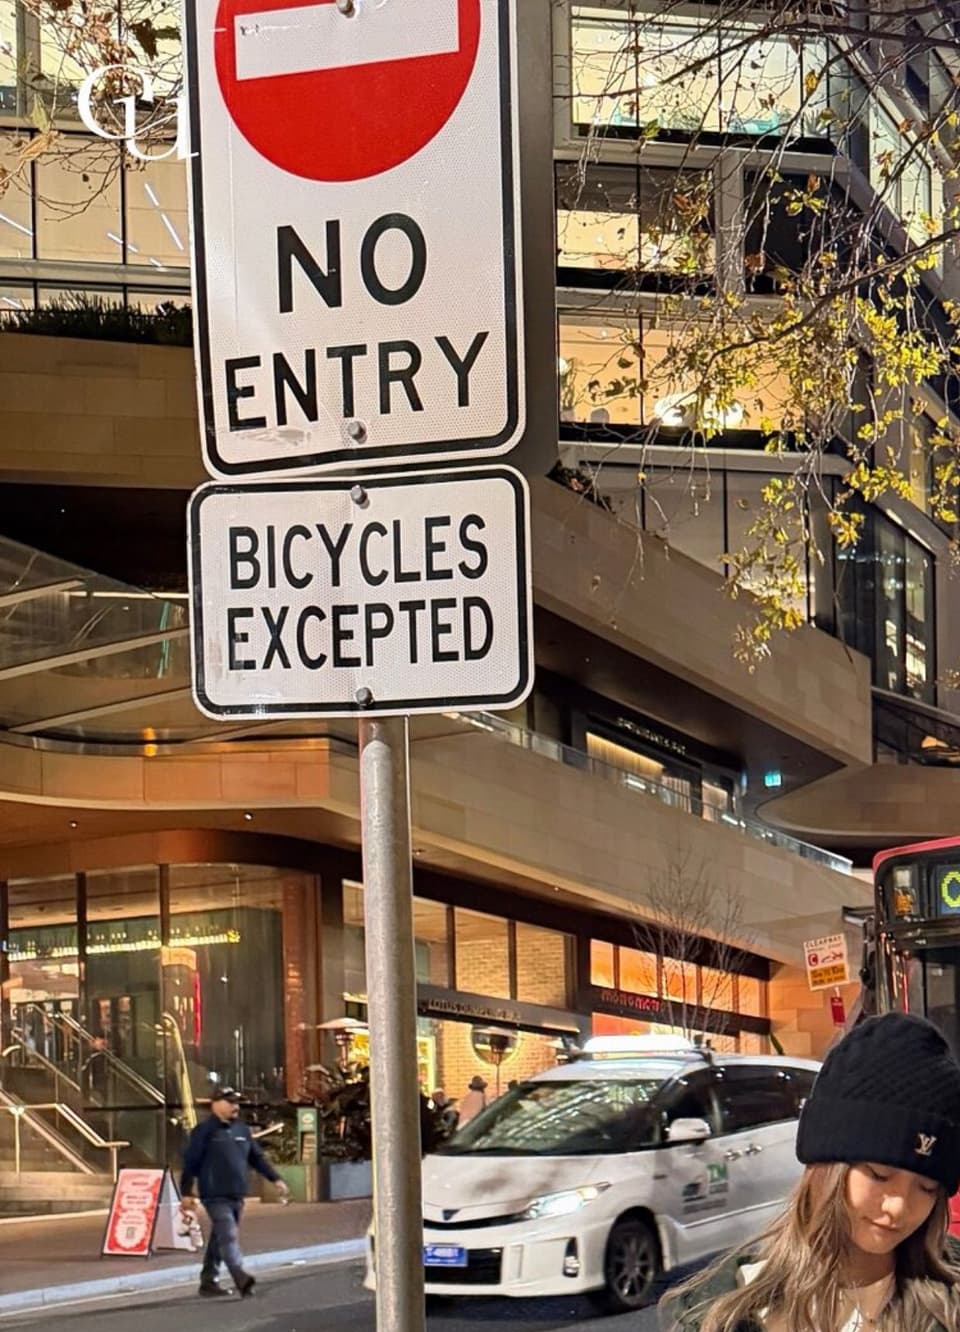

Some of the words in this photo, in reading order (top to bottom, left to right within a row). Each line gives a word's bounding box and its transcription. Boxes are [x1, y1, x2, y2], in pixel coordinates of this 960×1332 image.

[276, 212, 427, 314] NO
[225, 331, 489, 432] ENTRY
[229, 513, 488, 590] BICYCLES
[227, 596, 494, 671] EXCEPTED
